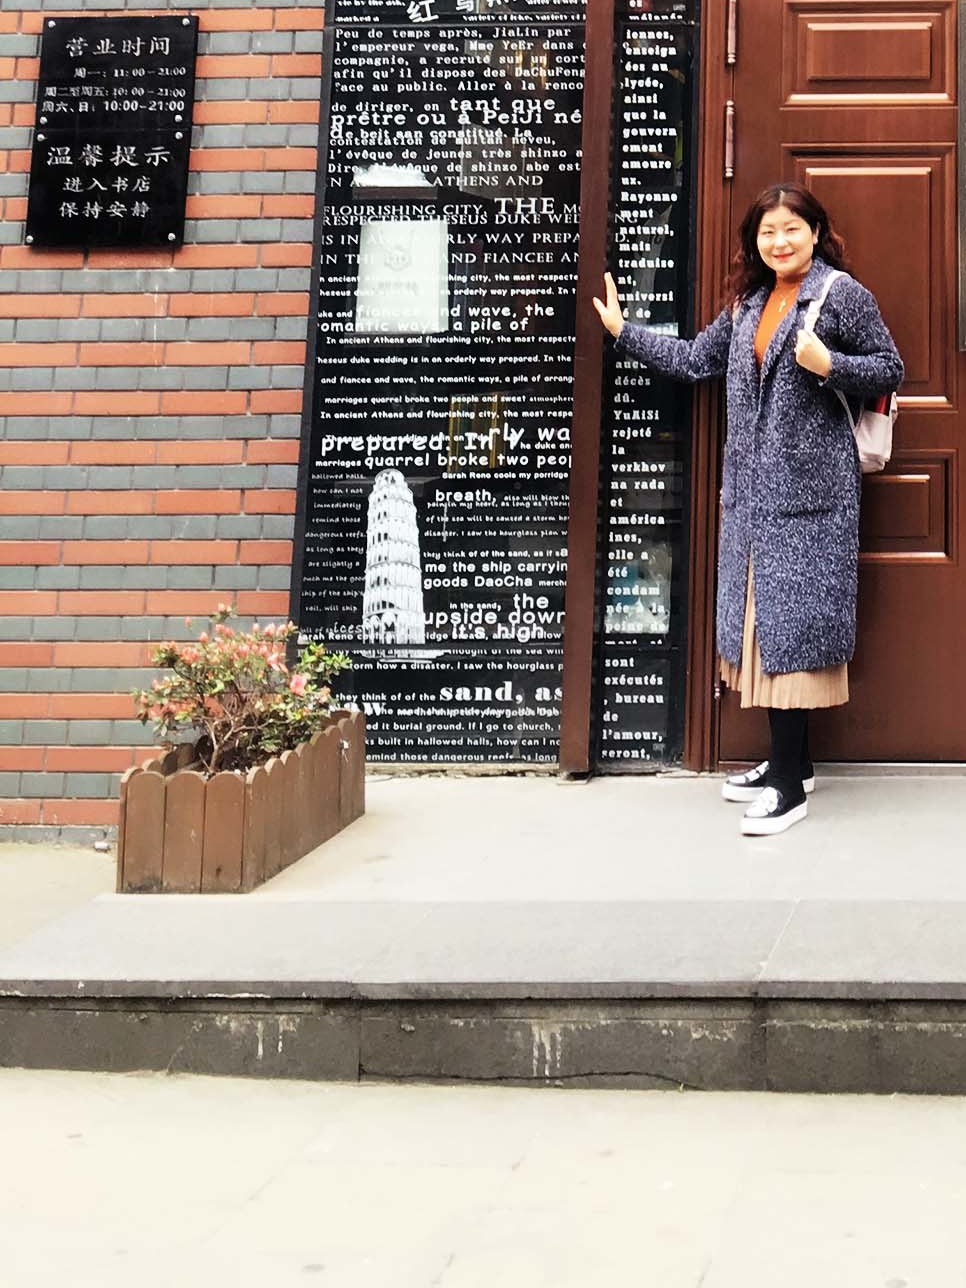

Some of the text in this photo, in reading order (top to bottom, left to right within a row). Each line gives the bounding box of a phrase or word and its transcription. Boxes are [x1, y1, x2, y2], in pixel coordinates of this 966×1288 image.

[335, 27, 571, 39] Peu de temps après, par
[65, 36, 171, 57] 营业时间
[334, 54, 490, 67] compagnie, a recruté
[372, 67, 506, 79] qu'il dispose des
[372, 80, 535, 93] au public. Aller à la
[450, 97, 500, 113] tant
[331, 109, 543, 129] prêtre ou PeiJi
[47, 143, 171, 167] 温馨提示
[62, 175, 151, 193] 进入书店
[433, 174, 543, 187] ATHENS AND
[59, 200, 151, 219] 保持安静
[442, 197, 555, 216] CITY, THE
[495, 213, 540, 224] DUKE
[485, 232, 524, 244] WAY
[483, 252, 553, 263] FIANCEE
[468, 302, 554, 320] wave, the
[452, 316, 528, 334] a pile of
[364, 452, 528, 469] quarrel broke two
[435, 488, 496, 505] breath,
[424, 561, 511, 574] me the ship
[423, 574, 532, 589] goods DaoCha
[512, 592, 549, 610] the
[604, 673, 663, 686] exécutés
[439, 680, 523, 705] sand,
[393, 721, 553, 732] burial ground. church,
[378, 736, 493, 746] built in hallowed halls,
